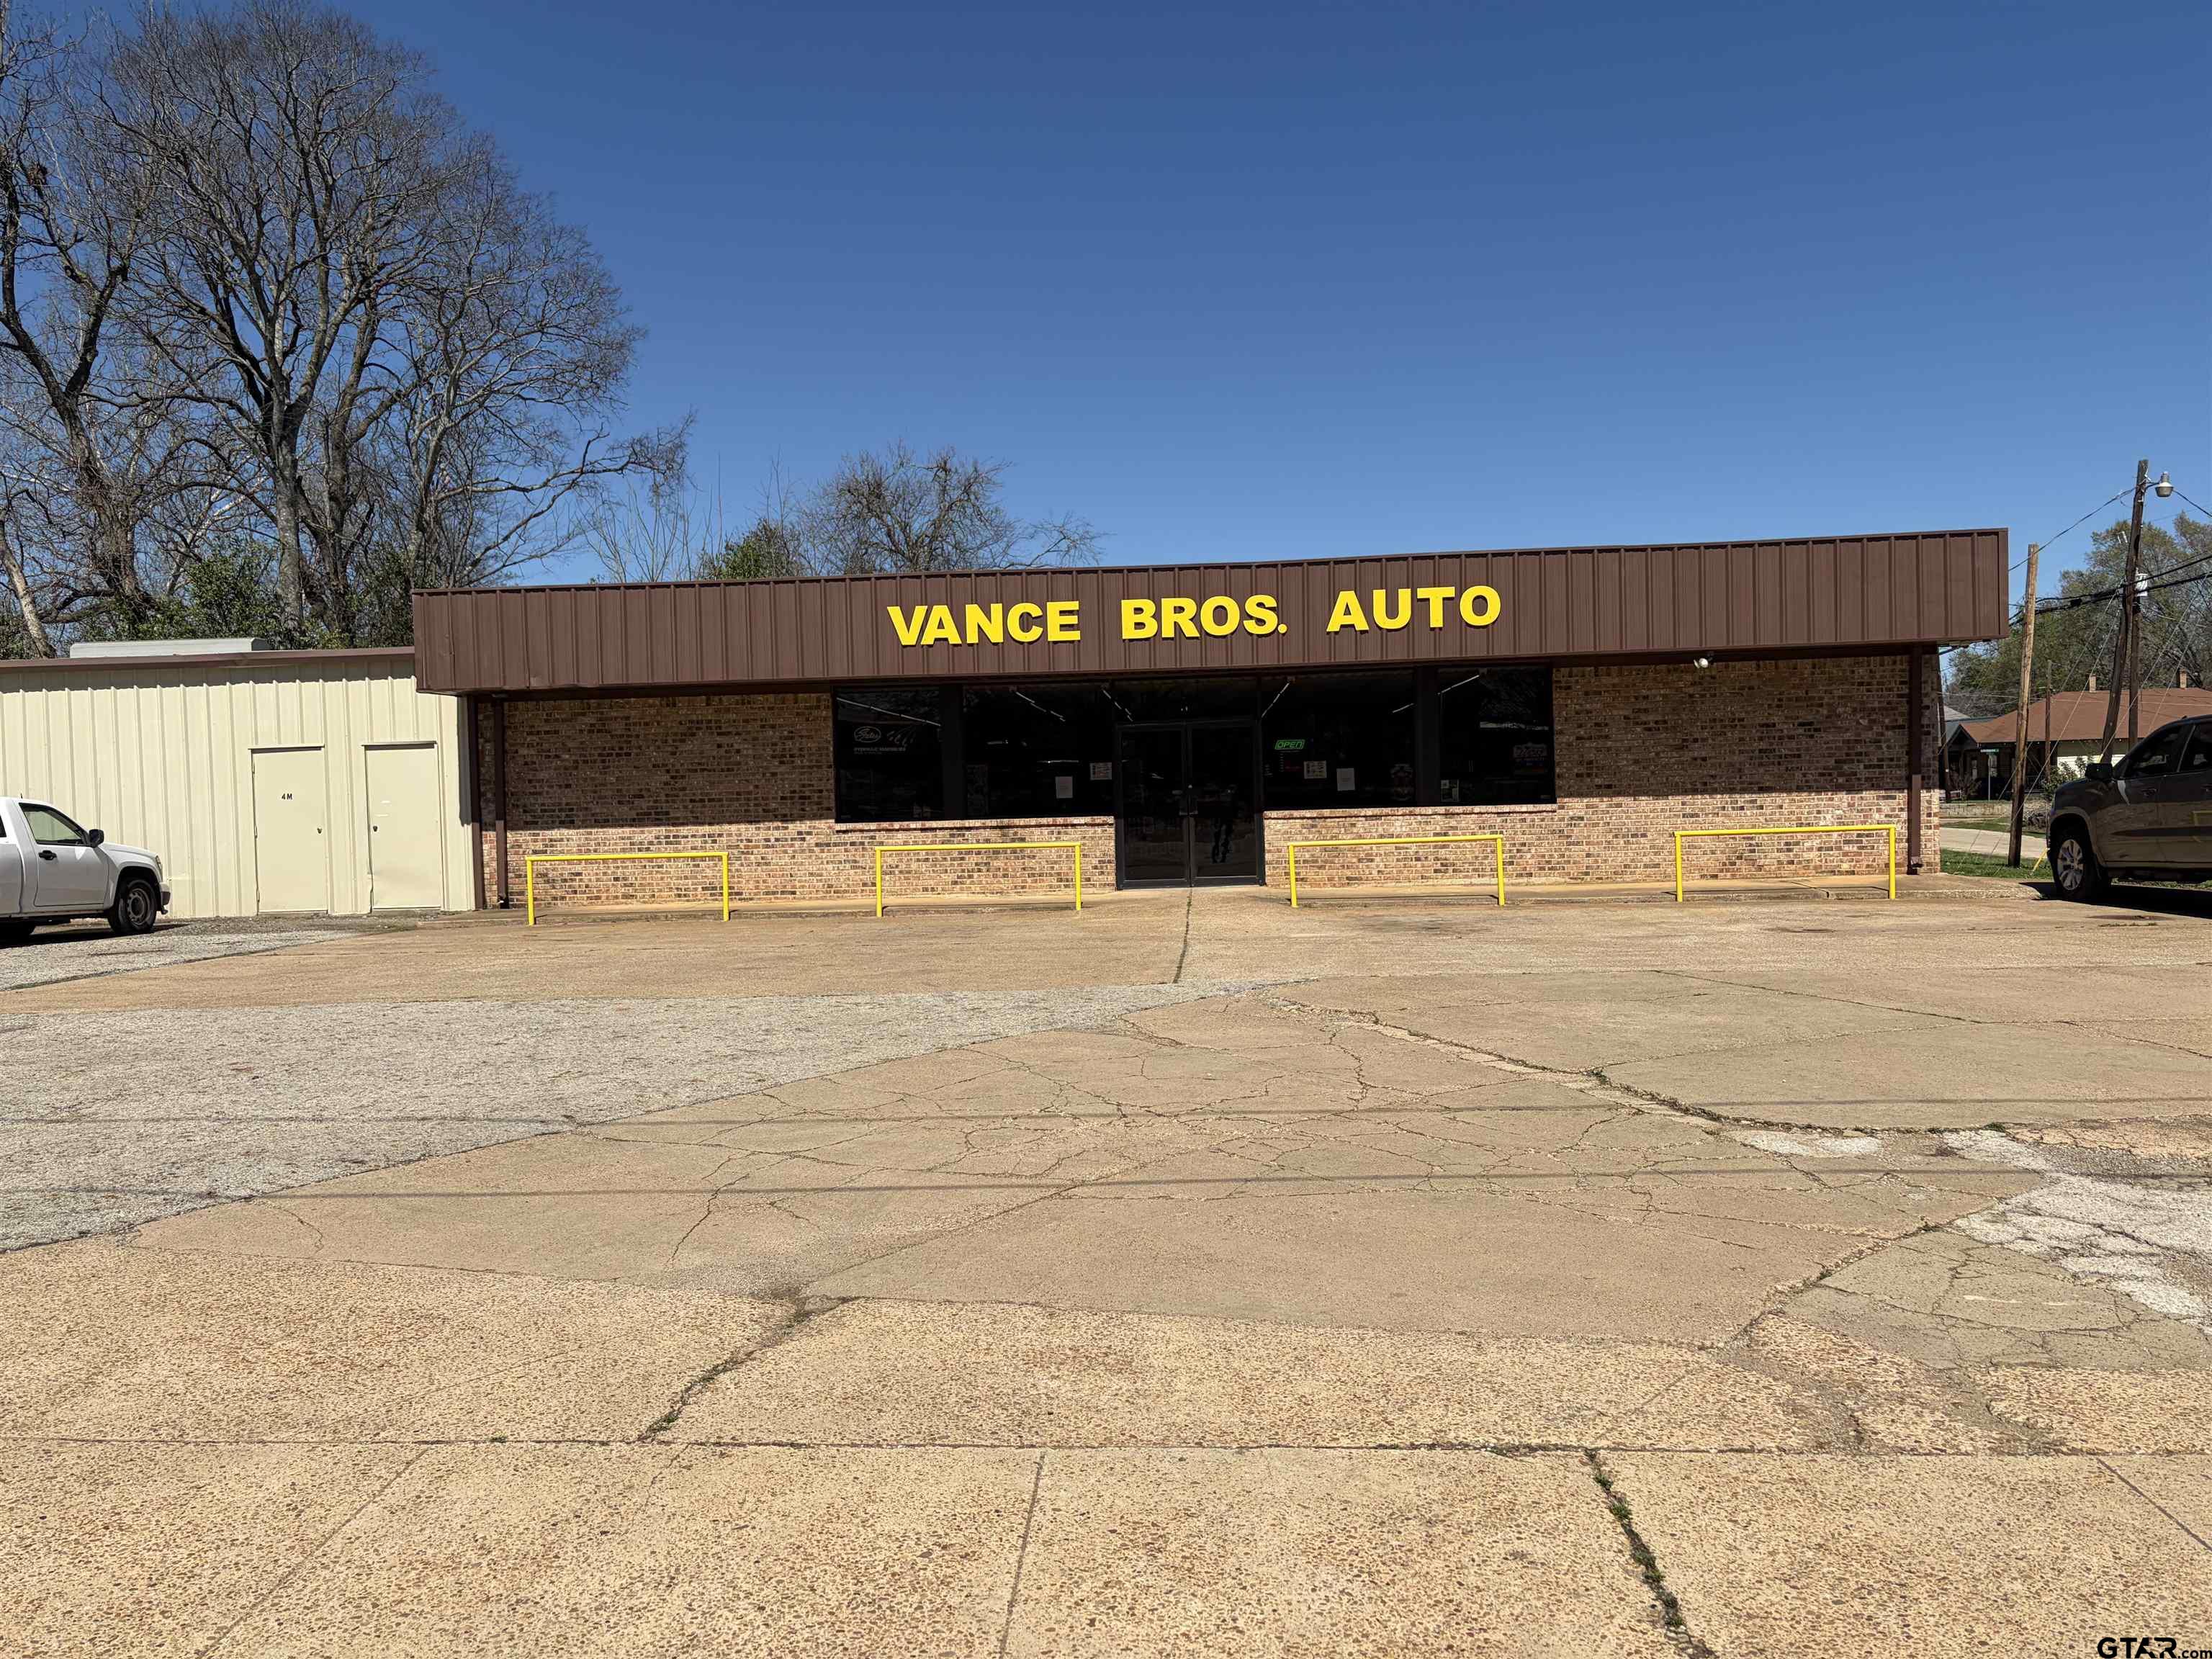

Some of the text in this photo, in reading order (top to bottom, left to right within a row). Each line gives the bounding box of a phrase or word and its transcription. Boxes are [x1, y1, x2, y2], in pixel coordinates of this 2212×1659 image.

[887, 585, 1501, 646] VANCE BROS. AUTO
